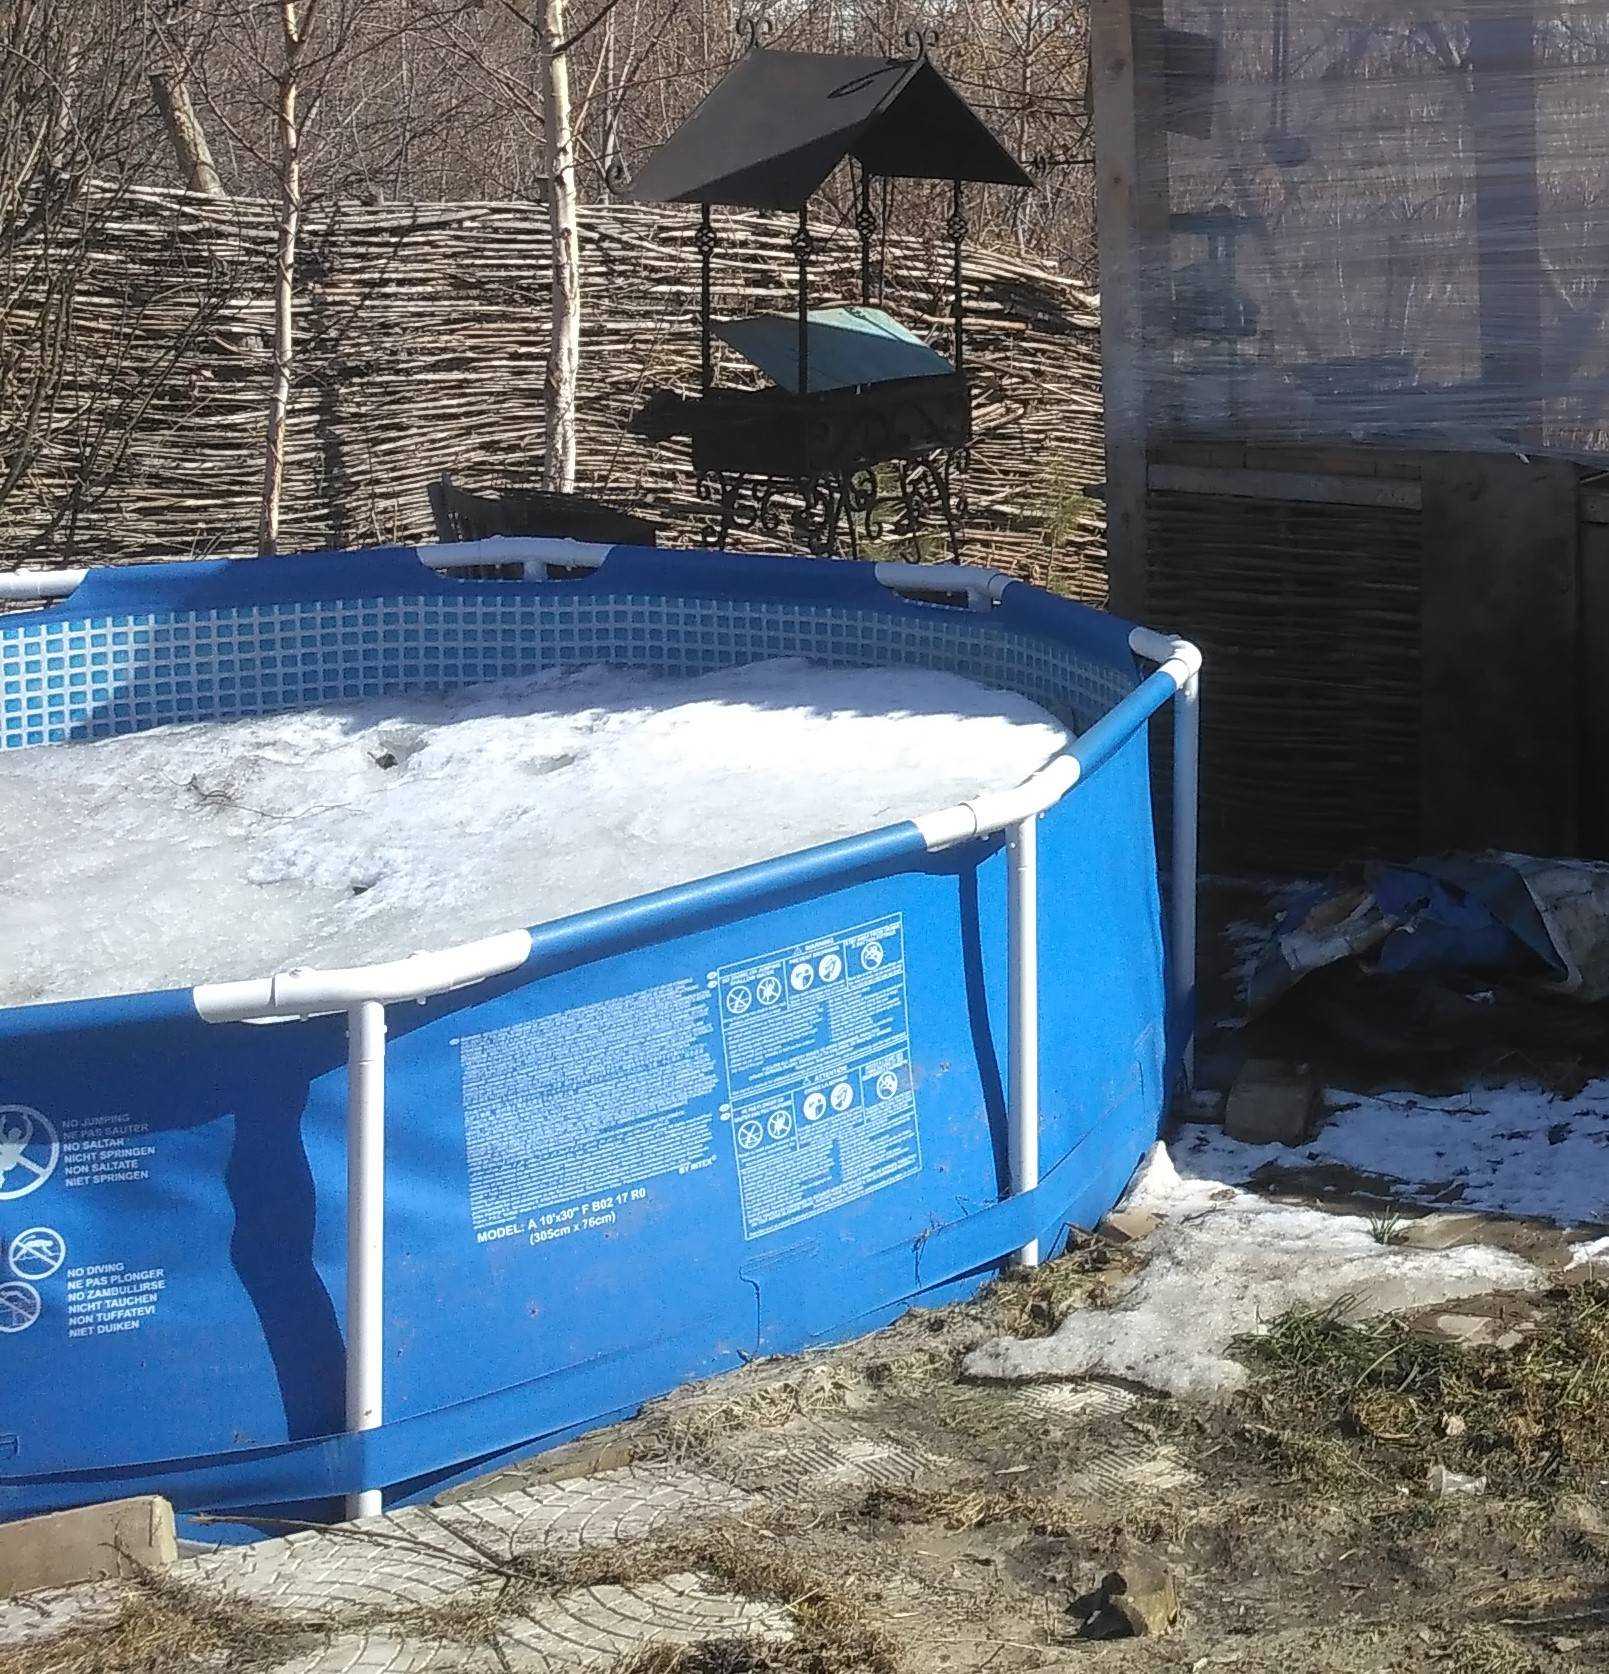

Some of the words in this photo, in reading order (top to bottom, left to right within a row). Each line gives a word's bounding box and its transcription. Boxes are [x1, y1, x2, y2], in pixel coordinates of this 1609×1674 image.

[62, 1120, 79, 1128] NO
[81, 1113, 130, 1127] JUMPING
[104, 1123, 150, 1136] SAUTER
[63, 1142, 80, 1152] NO
[64, 1152, 97, 1163] NICHT
[99, 1146, 156, 1160] SPRINGEN
[65, 1164, 89, 1175] NON
[91, 1159, 139, 1172] SALTATE
[65, 1176, 91, 1187] NIET
[92, 1170, 149, 1184] SPRINGEN
[528, 1218, 538, 1231] A
[582, 1204, 590, 1216] F
[592, 1199, 614, 1212] B02
[616, 1192, 629, 1205] 17
[529, 1226, 571, 1246] (305cm
[573, 1223, 581, 1233] x
[582, 1211, 617, 1230] 76cm)
[67, 1268, 85, 1278] NO
[87, 1262, 125, 1276] DIVING
[67, 1280, 84, 1290] NE
[86, 1276, 109, 1288] PAS
[110, 1268, 165, 1285] PLONGER
[67, 1292, 85, 1302] NO
[87, 1280, 166, 1301] ZAMBULLIRSE
[68, 1301, 103, 1314] NICHT
[105, 1293, 159, 1309] TAUCHEN
[69, 1314, 94, 1326] NON
[96, 1305, 156, 1322] TUFFATEVI
[69, 1326, 95, 1338] NIET
[97, 1319, 140, 1334] DUIKEN
